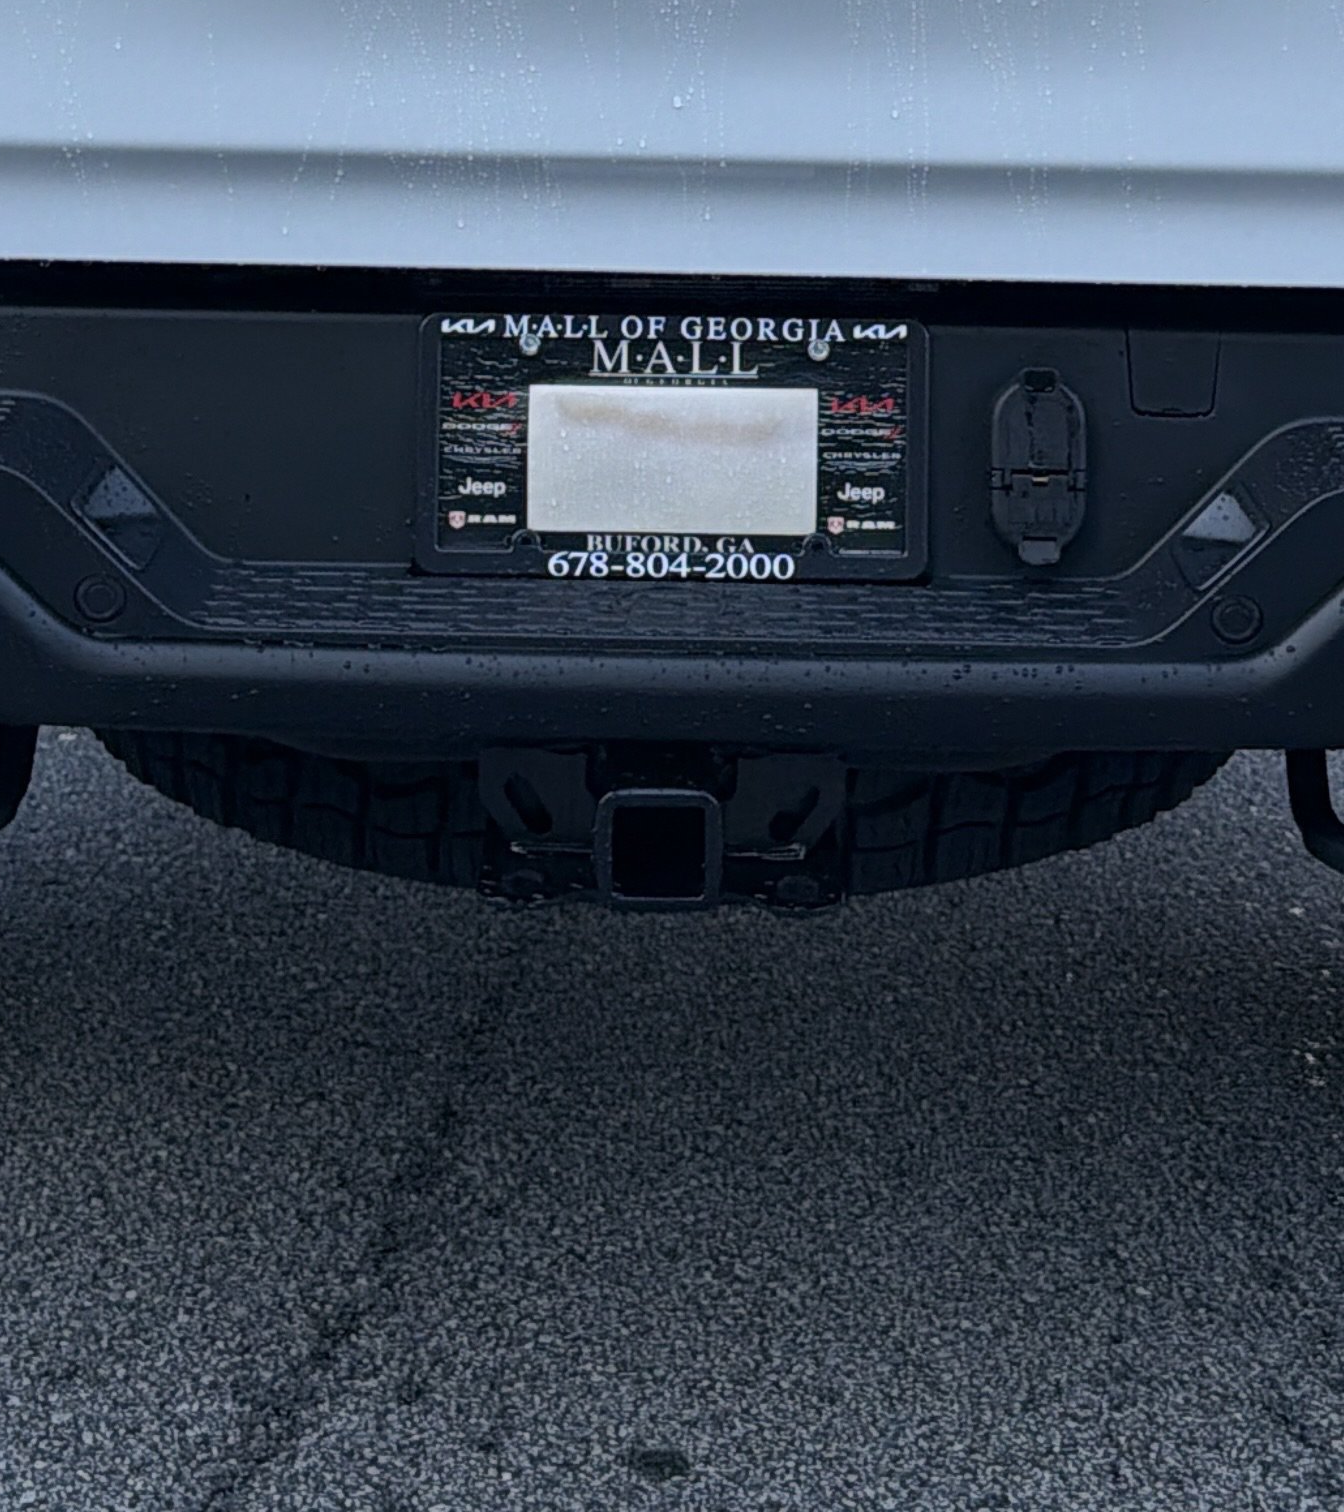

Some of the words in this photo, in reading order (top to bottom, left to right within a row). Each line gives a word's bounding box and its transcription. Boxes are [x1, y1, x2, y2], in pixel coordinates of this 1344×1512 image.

[621, 315, 666, 339] OF
[680, 316, 846, 341] GEORGIA
[457, 477, 507, 498] Jeep
[837, 482, 885, 504] Jeep
[467, 514, 517, 524] RAM
[846, 520, 896, 530] RAM
[716, 537, 755, 553] GA
[548, 551, 796, 579] 678-804-2000
